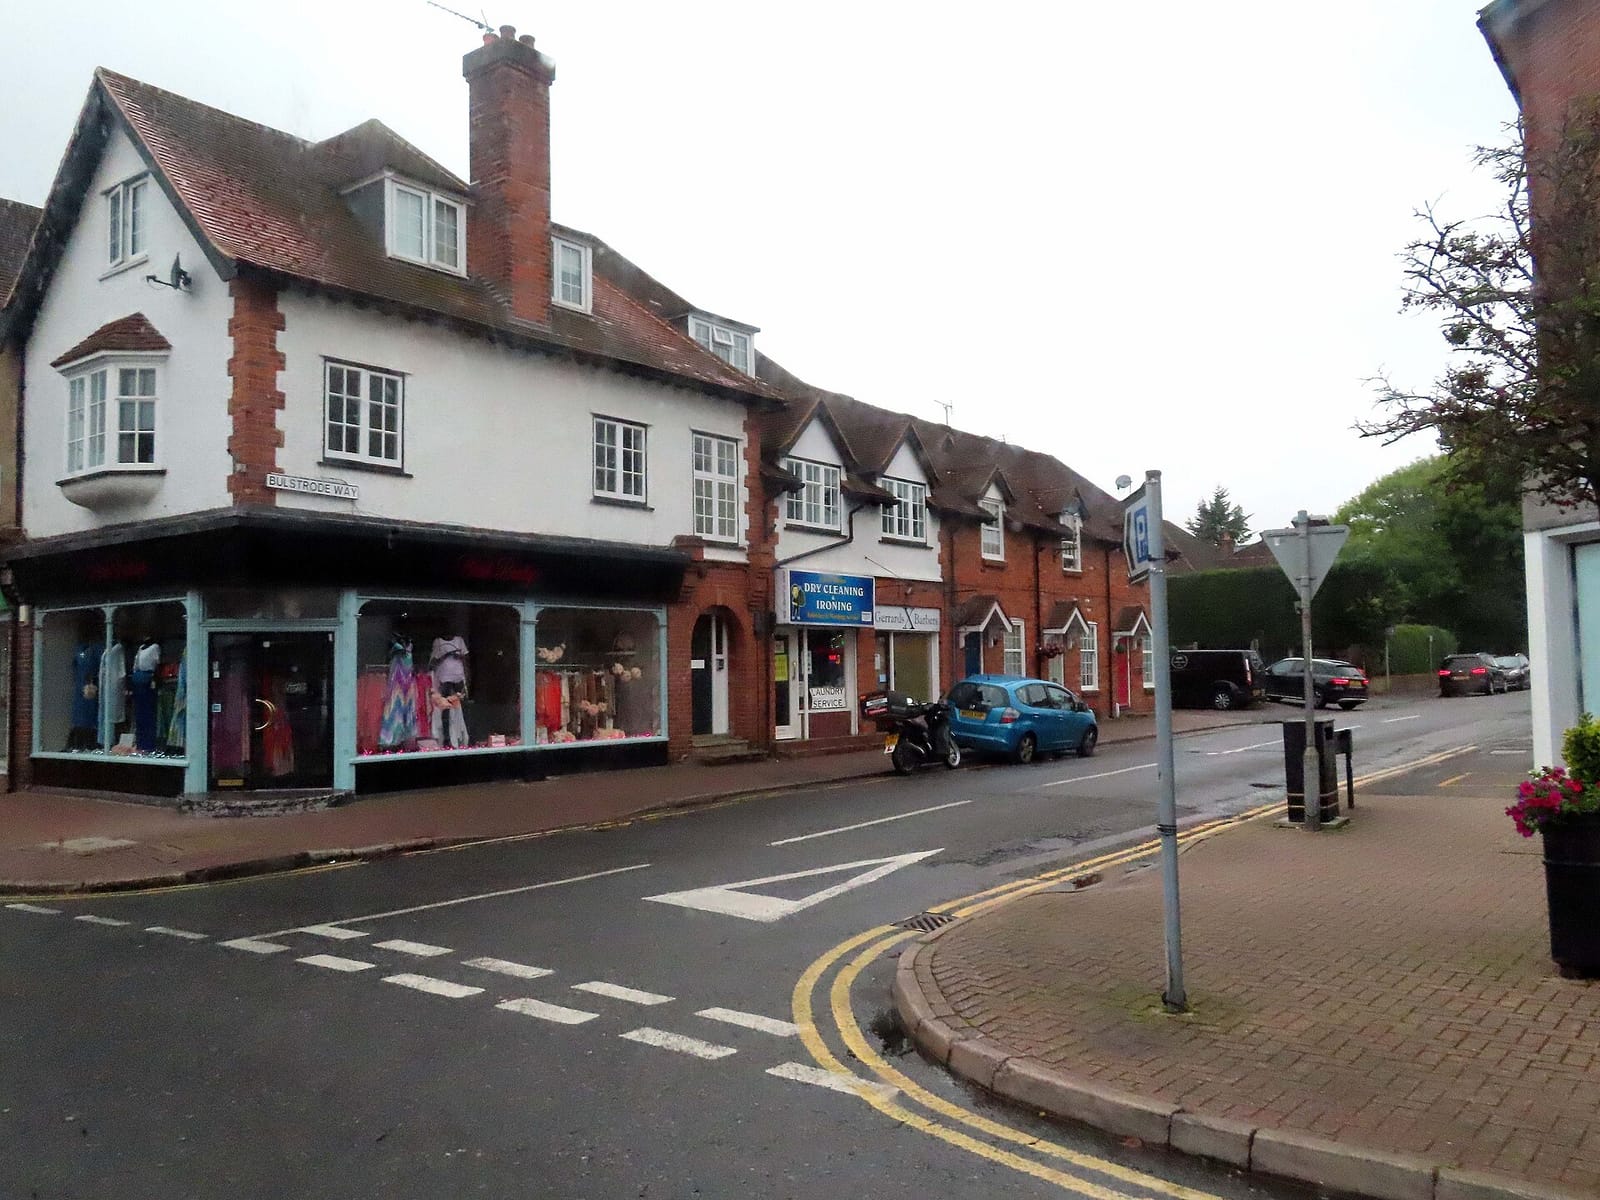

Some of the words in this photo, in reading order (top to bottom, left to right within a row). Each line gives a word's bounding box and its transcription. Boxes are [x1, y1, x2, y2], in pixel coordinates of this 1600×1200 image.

[269, 476, 331, 494] BULSTRODE
[334, 485, 358, 497] WAY
[1136, 515, 1146, 558] P
[804, 583, 821, 593] DRY
[823, 584, 864, 597] CLEANING
[816, 600, 853, 611] IRONING
[811, 688, 843, 697] LAUNDRY
[813, 699, 843, 708] SERVICE
